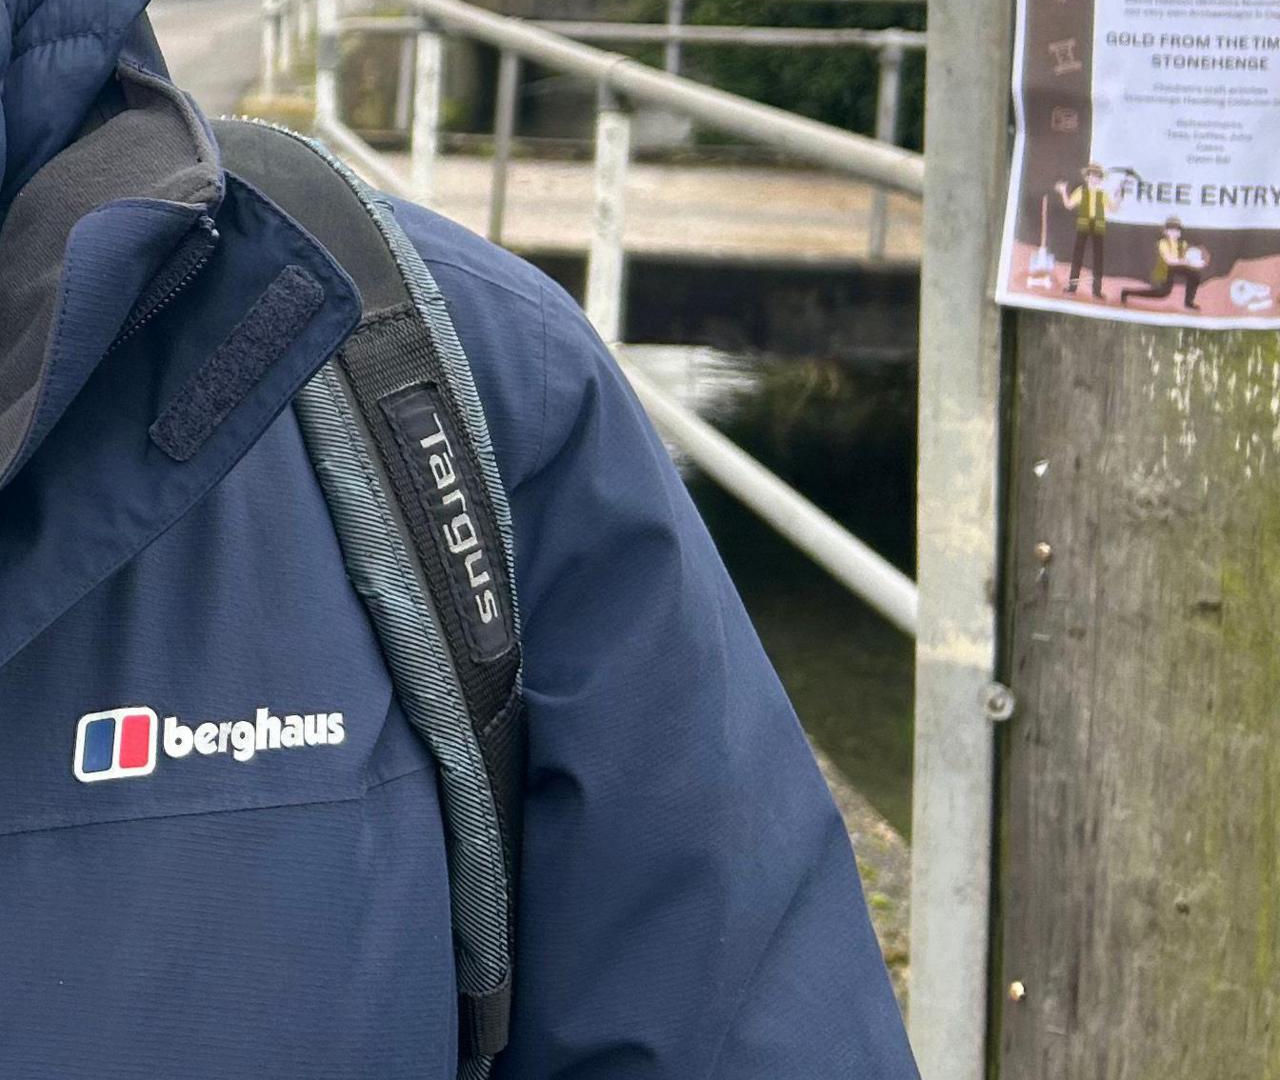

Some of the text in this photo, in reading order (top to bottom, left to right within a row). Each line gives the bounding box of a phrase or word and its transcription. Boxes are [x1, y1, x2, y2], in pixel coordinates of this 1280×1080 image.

[1106, 31, 1155, 49] GOLD
[1160, 33, 1211, 50] FROM
[1215, 34, 1249, 50] THE
[1151, 53, 1271, 71] STONEHENGE
[1120, 180, 1193, 206] FREE
[419, 412, 499, 625] Targus
[163, 706, 346, 762] berghaus
